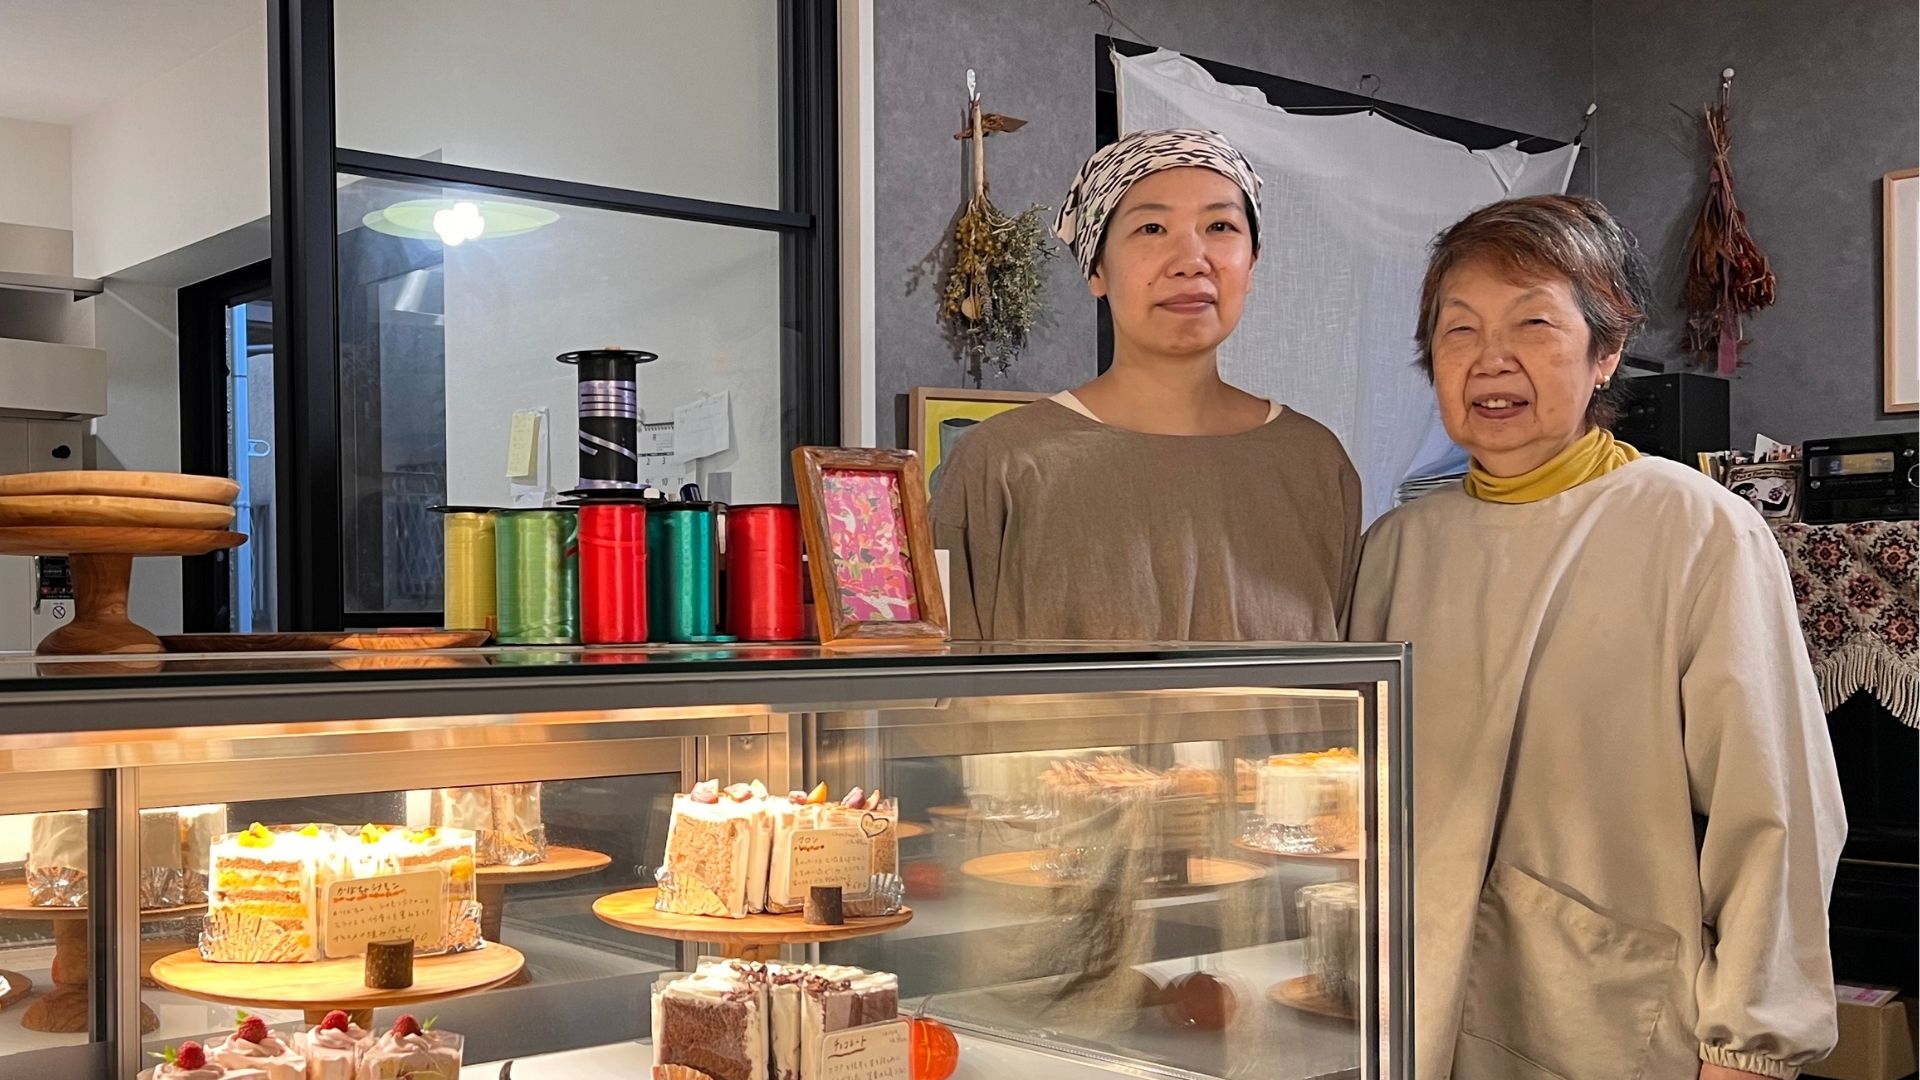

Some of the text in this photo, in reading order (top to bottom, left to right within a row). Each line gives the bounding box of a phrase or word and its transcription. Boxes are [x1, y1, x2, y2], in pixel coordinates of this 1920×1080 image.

[834, 1035, 867, 1052] チョコレート
